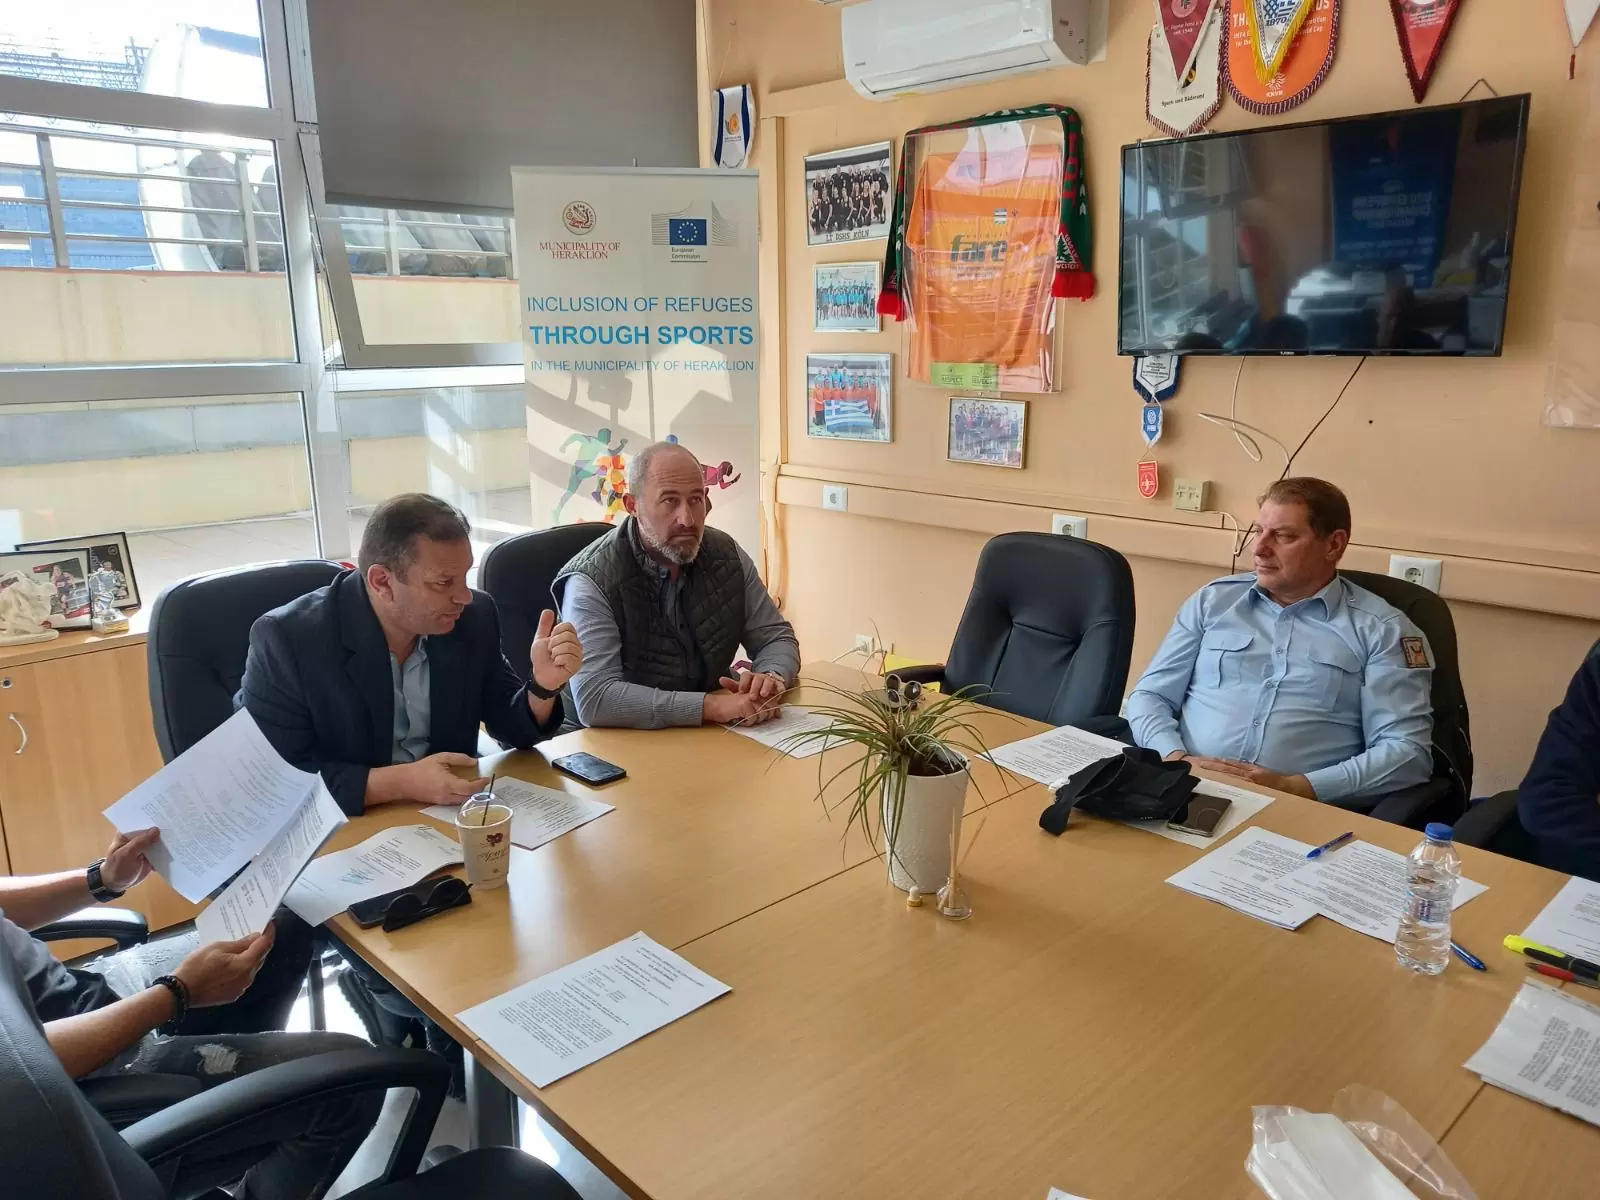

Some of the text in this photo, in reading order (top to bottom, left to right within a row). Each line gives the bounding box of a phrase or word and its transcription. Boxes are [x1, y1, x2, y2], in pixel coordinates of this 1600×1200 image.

[539, 241, 620, 251] MUNICIPALITY OF
[950, 233, 1008, 262] fare
[551, 250, 608, 260] HERAKLION
[527, 296, 754, 313] INCLUSION OF REFUGES
[529, 325, 754, 345] THROUGH SPORTS
[531, 360, 754, 371] IN THE MUNICIPALITY OF HERAKLION
